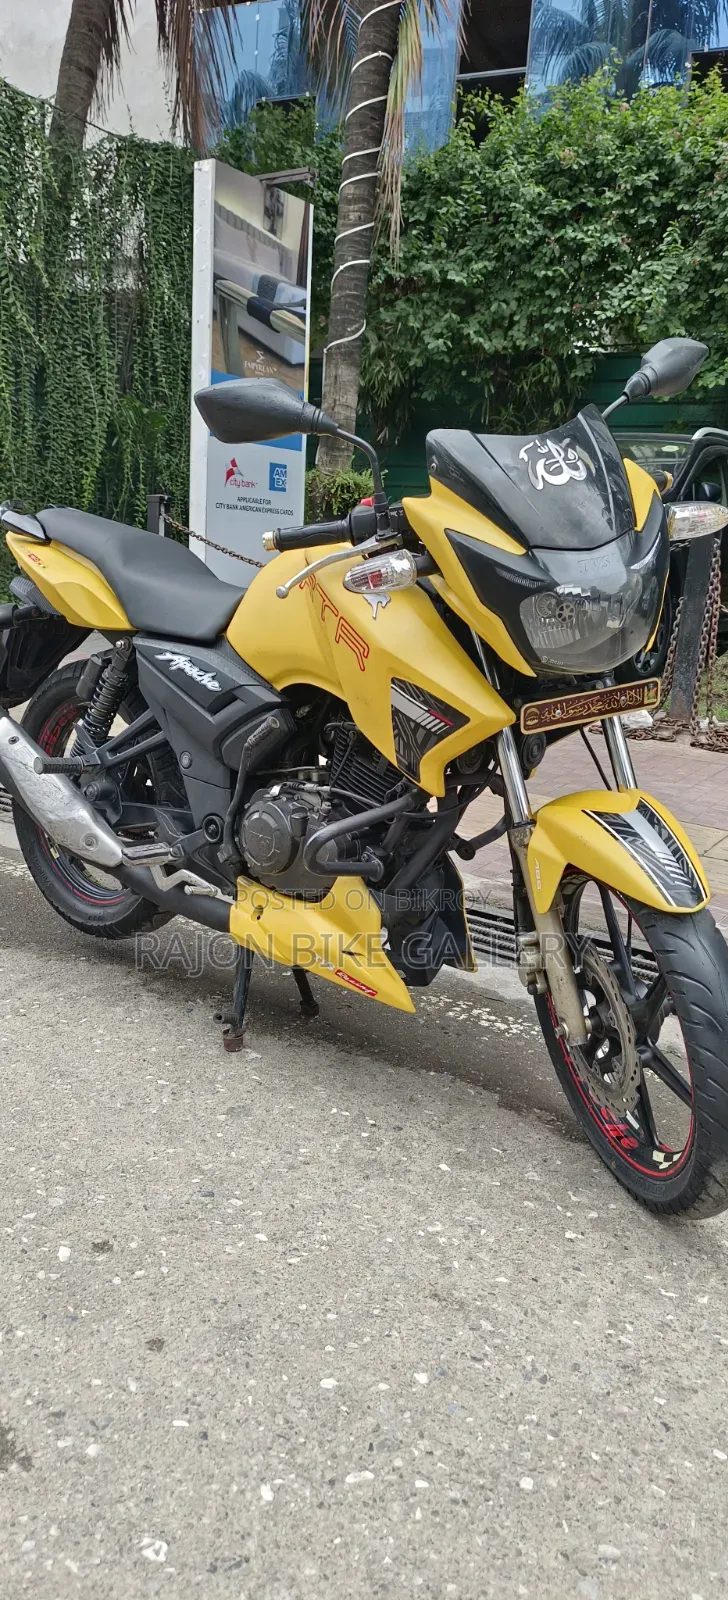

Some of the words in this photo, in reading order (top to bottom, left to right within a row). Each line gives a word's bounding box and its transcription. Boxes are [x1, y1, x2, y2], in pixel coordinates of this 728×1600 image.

[273, 468, 287, 478] AM
[230, 478, 241, 488] city
[241, 479, 256, 489] bank
[274, 478, 287, 488] EX
[237, 496, 263, 504] APPLICABLE
[226, 503, 239, 511] BANK
[239, 504, 262, 513] AMERICAN
[262, 507, 280, 515] EXPRESS
[280, 508, 294, 516] CARDS
[154, 652, 222, 692] Apache
